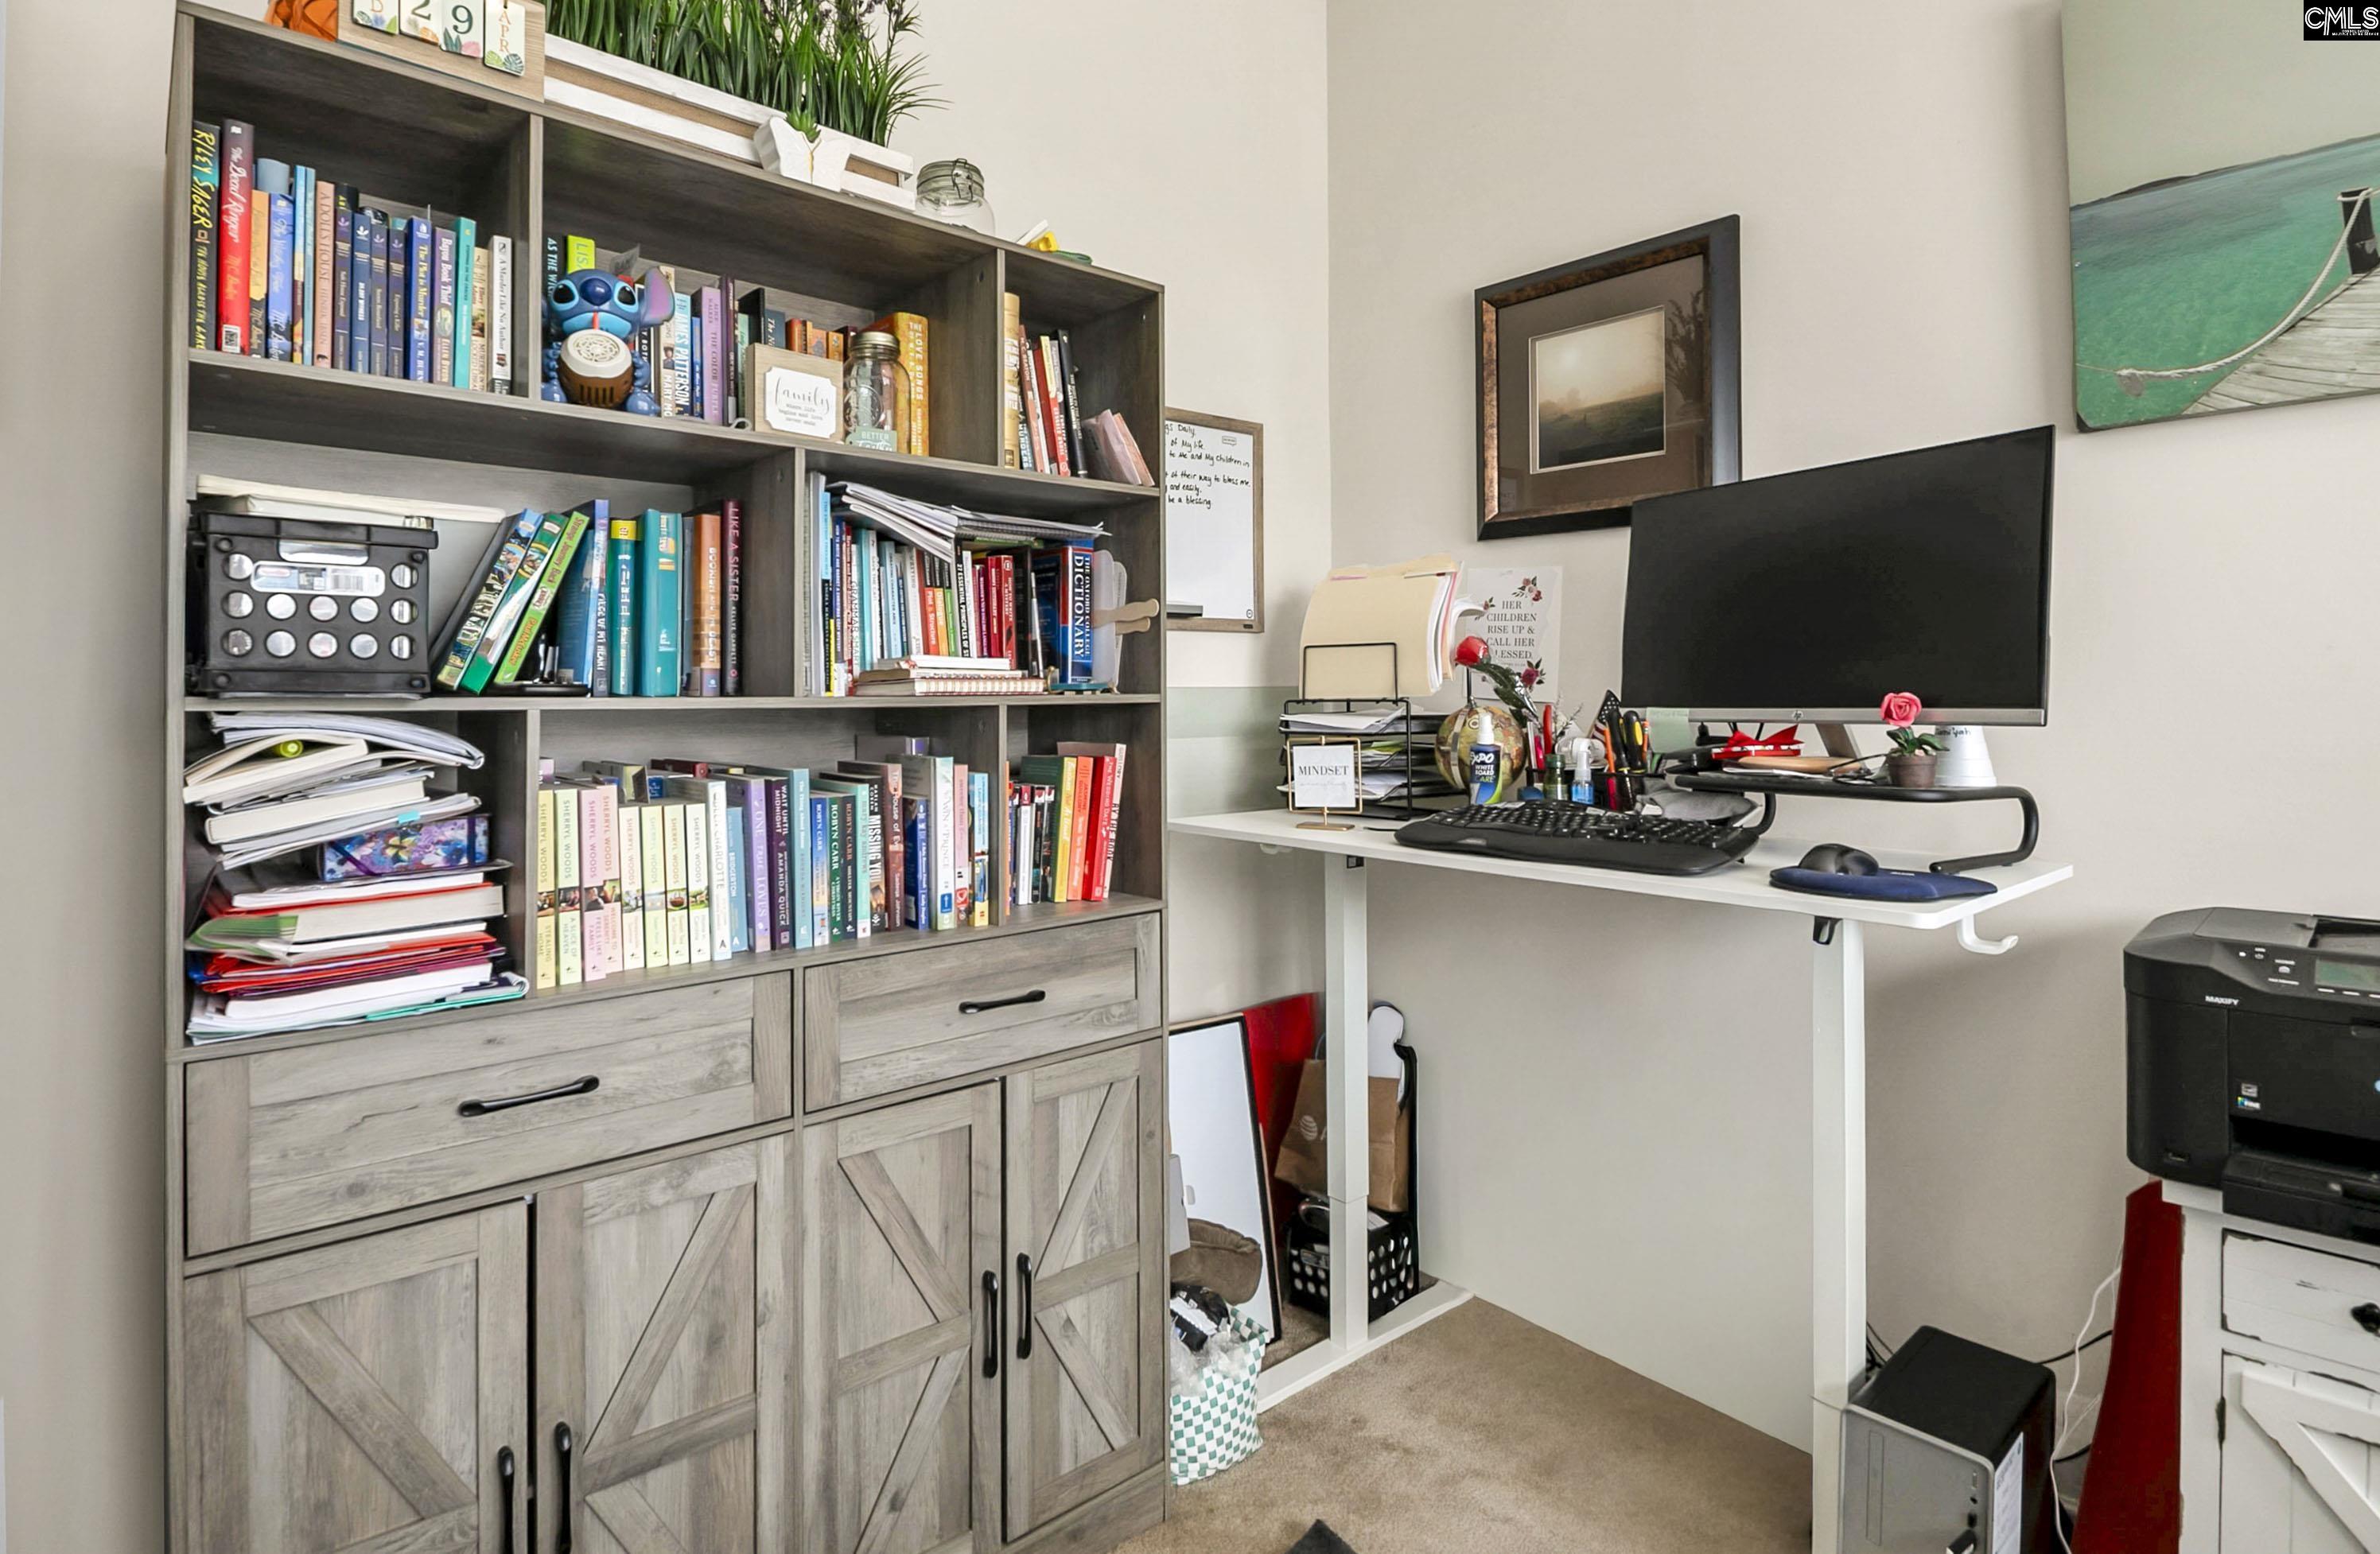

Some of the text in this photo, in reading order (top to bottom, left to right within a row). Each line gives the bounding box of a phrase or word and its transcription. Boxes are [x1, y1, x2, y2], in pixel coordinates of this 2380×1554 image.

[192, 129, 216, 230] RILEY SAGER
[438, 238, 453, 306] Bayou Book Thief
[674, 312, 690, 405] JAMES PATTERSON
[1018, 423, 1029, 468] MURDERS
[1177, 423, 1196, 438] Daily
[729, 507, 739, 537] LIKE
[729, 556, 739, 602] SISTER
[957, 572, 966, 604] ESSENTIAL
[935, 591, 945, 627] Dialogue
[959, 604, 968, 639] PRINCIPLES
[1074, 554, 1085, 658] DICTIONARY
[1486, 612, 1538, 623] CHILDREN
[1501, 600, 1522, 610] HER
[928, 612, 937, 646] Structure
[1486, 637, 1535, 647] CALL HER
[1487, 625, 1535, 635] RISE UP &
[1299, 765, 1350, 776] MINDSET
[754, 810, 764, 837] ONE
[845, 802, 854, 834] ROBYN
[892, 791, 901, 821] House
[562, 799, 573, 879] SHERRYL WOODS
[587, 800, 598, 879] SHERRYL WOODS
[602, 795, 612, 872] SHERRYL WOODS
[830, 804, 840, 870] ROBYN CARR
[869, 814, 882, 883] MISSING YOU
[694, 853, 702, 884] WOODS
[756, 876, 768, 917] LOVES
[777, 852, 787, 927] AMANDA QUICK
[2204, 995, 2239, 1006] MAXIFY
